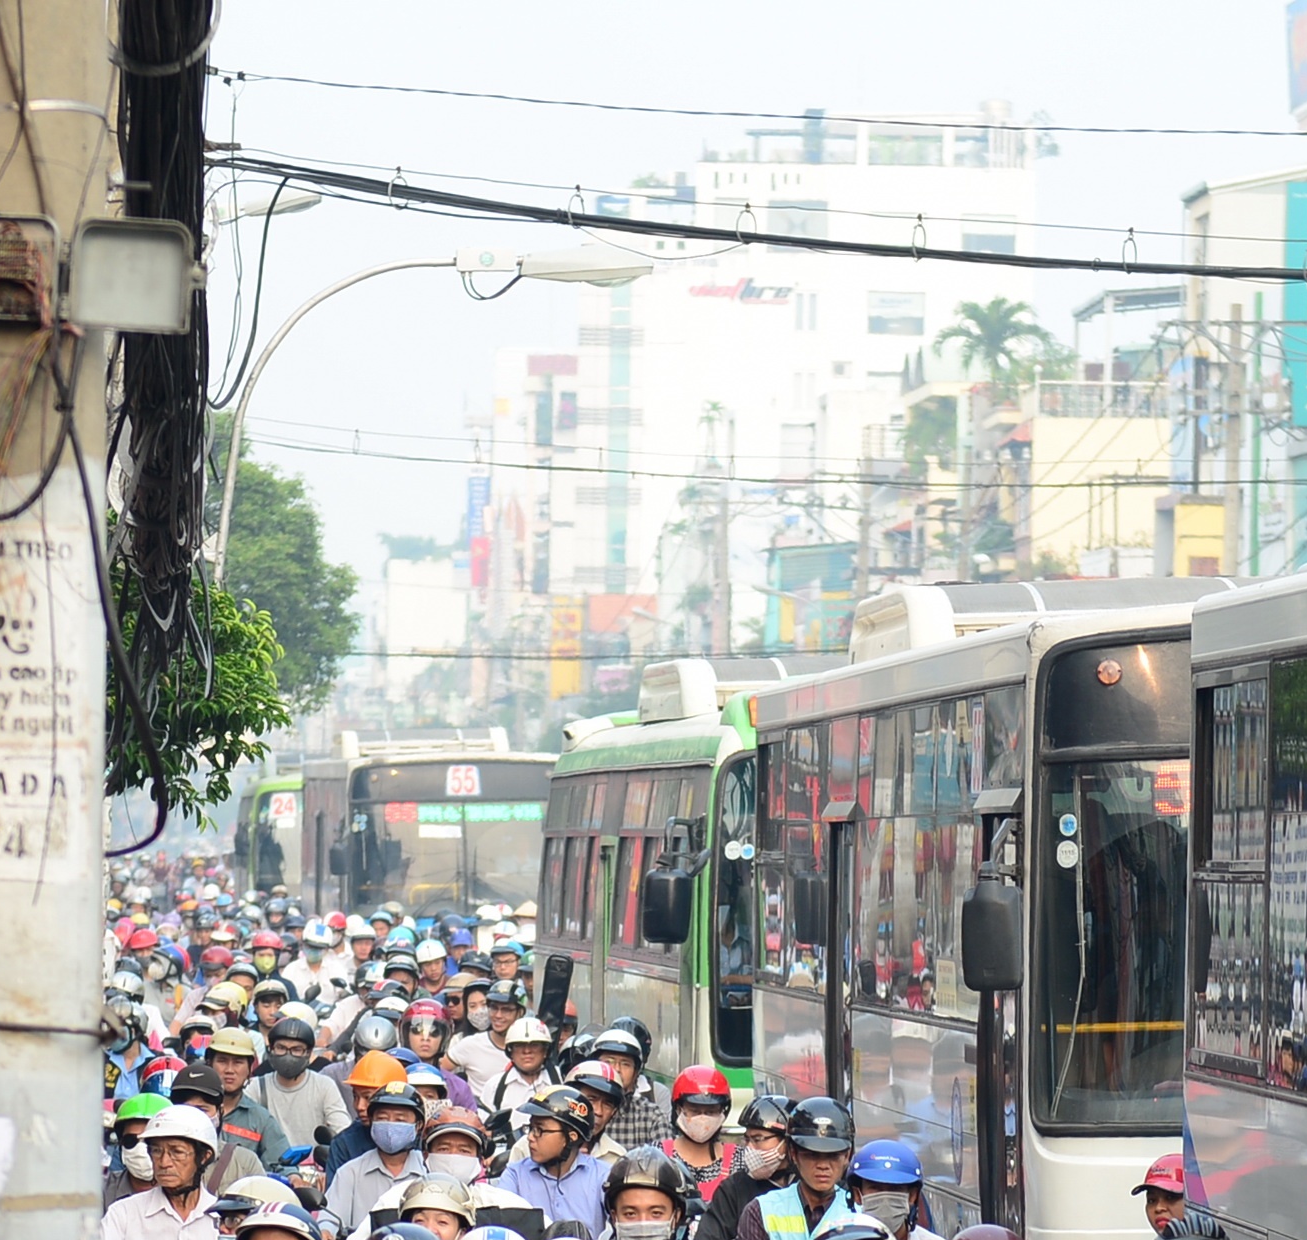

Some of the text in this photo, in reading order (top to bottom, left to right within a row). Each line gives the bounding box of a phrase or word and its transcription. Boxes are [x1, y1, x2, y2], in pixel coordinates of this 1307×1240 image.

[10, 667, 46, 681] cao
[451, 767, 476, 794] 55
[273, 797, 294, 815] 24
